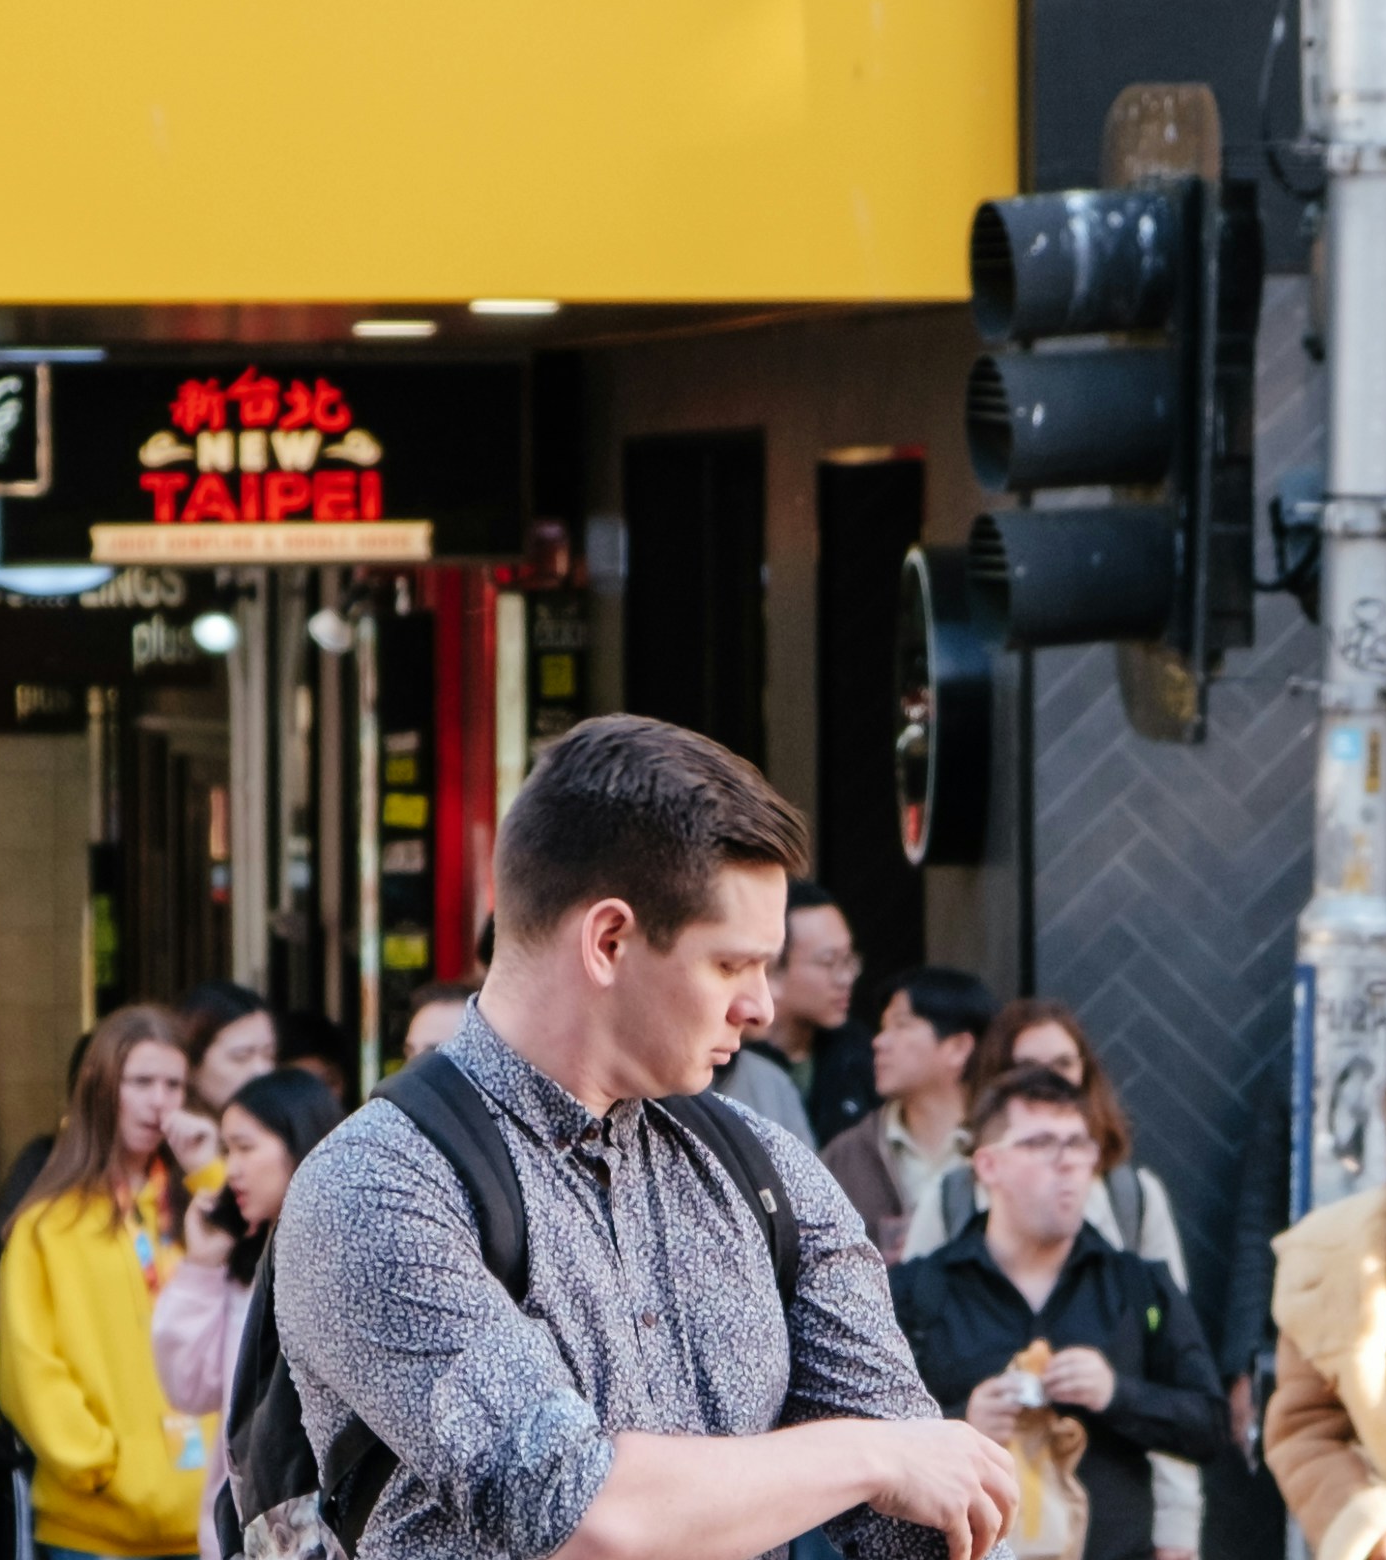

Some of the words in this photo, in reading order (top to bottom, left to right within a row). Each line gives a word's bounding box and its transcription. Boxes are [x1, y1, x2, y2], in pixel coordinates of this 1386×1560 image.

[169, 365, 352, 436] 新台北
[196, 428, 323, 473] NEW
[139, 471, 382, 523] TAIPEI
